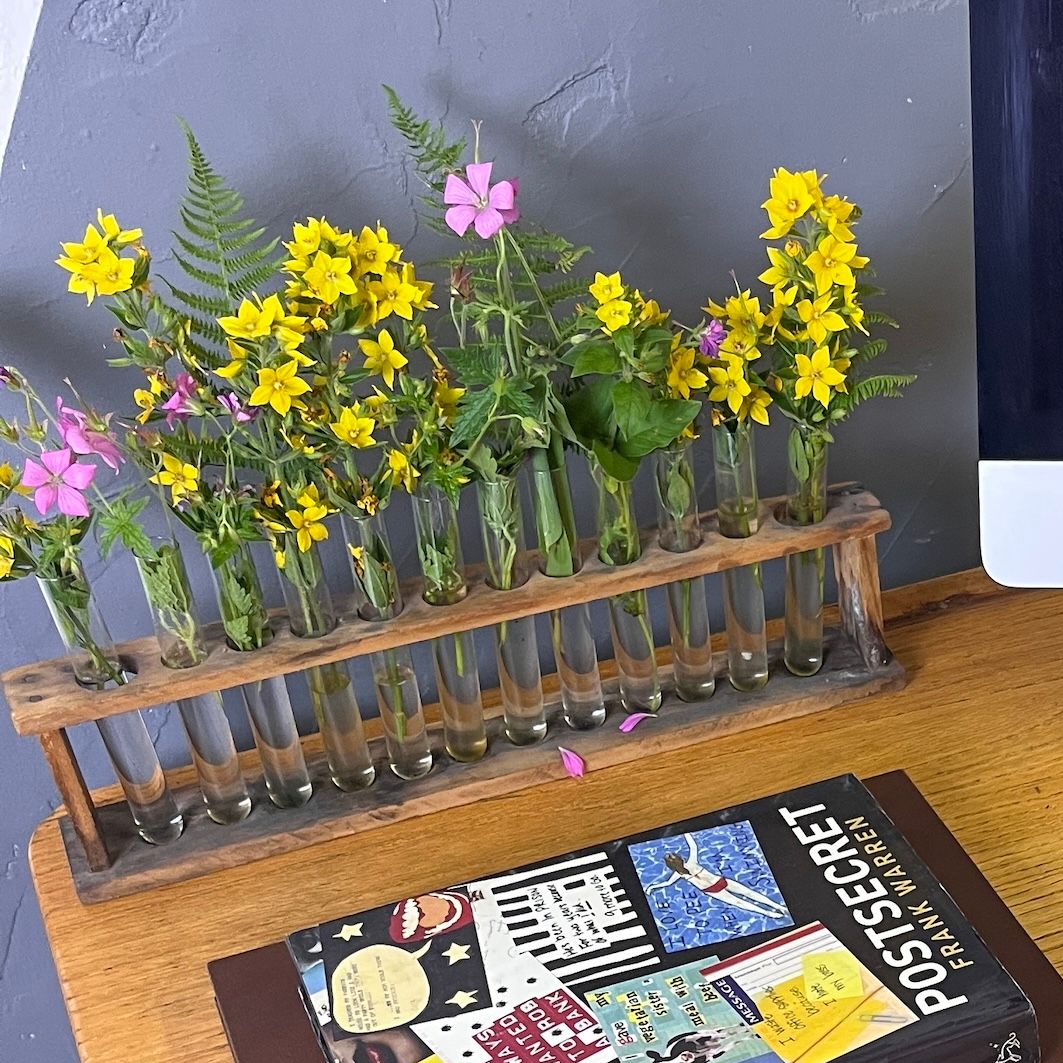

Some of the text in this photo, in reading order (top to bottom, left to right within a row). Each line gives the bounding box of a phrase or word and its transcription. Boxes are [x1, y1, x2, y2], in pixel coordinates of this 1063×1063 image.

[680, 890, 706, 915] PEE
[844, 815, 975, 970] FRANK WARREN
[655, 901, 679, 931] LOVE
[778, 803, 969, 1016] POSTSECRET
[551, 922, 565, 942] been
[808, 982, 829, 999] hate
[829, 977, 846, 991] my
[593, 991, 609, 1007] my
[646, 990, 668, 1016] sister
[668, 975, 704, 1027] meal with
[714, 977, 760, 1023] MESSAGE
[788, 984, 820, 1017] because
[518, 998, 585, 1061] TO ROB
[543, 990, 611, 1047] A BANK
[624, 990, 656, 1043] vegetarian
[760, 1011, 785, 1035] waste
[781, 1009, 806, 1030] office
[612, 1020, 634, 1046] gave
